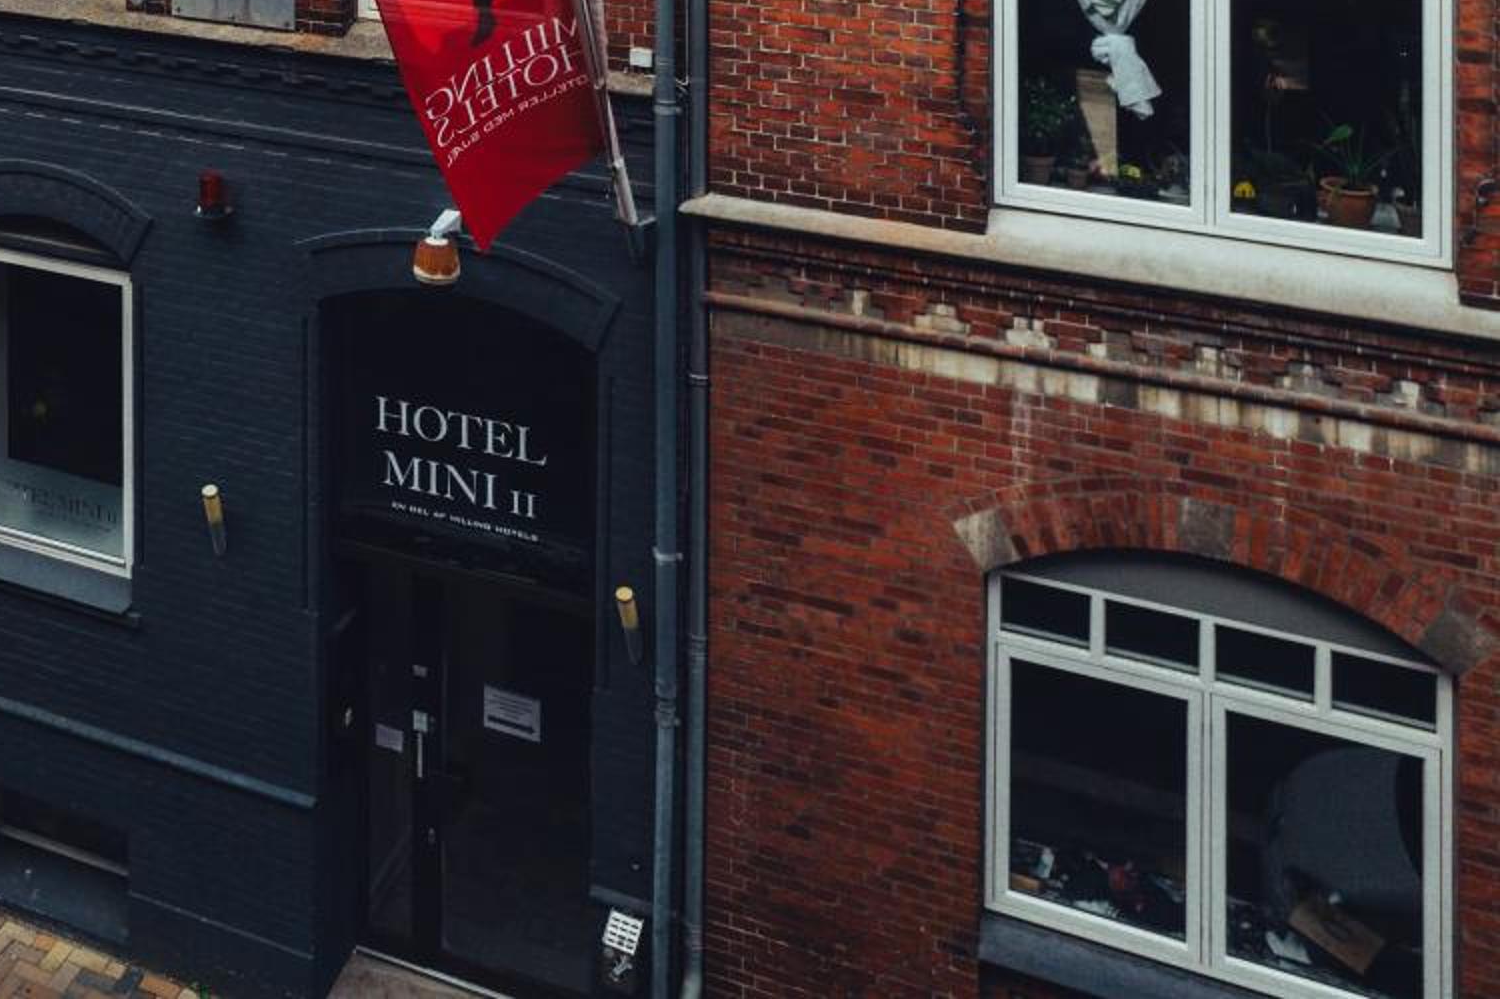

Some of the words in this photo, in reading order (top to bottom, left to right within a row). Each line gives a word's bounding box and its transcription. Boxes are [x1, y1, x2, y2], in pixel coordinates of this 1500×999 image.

[375, 395, 548, 466] HOTEL
[383, 450, 498, 510] MINI
[510, 490, 540, 518] II
